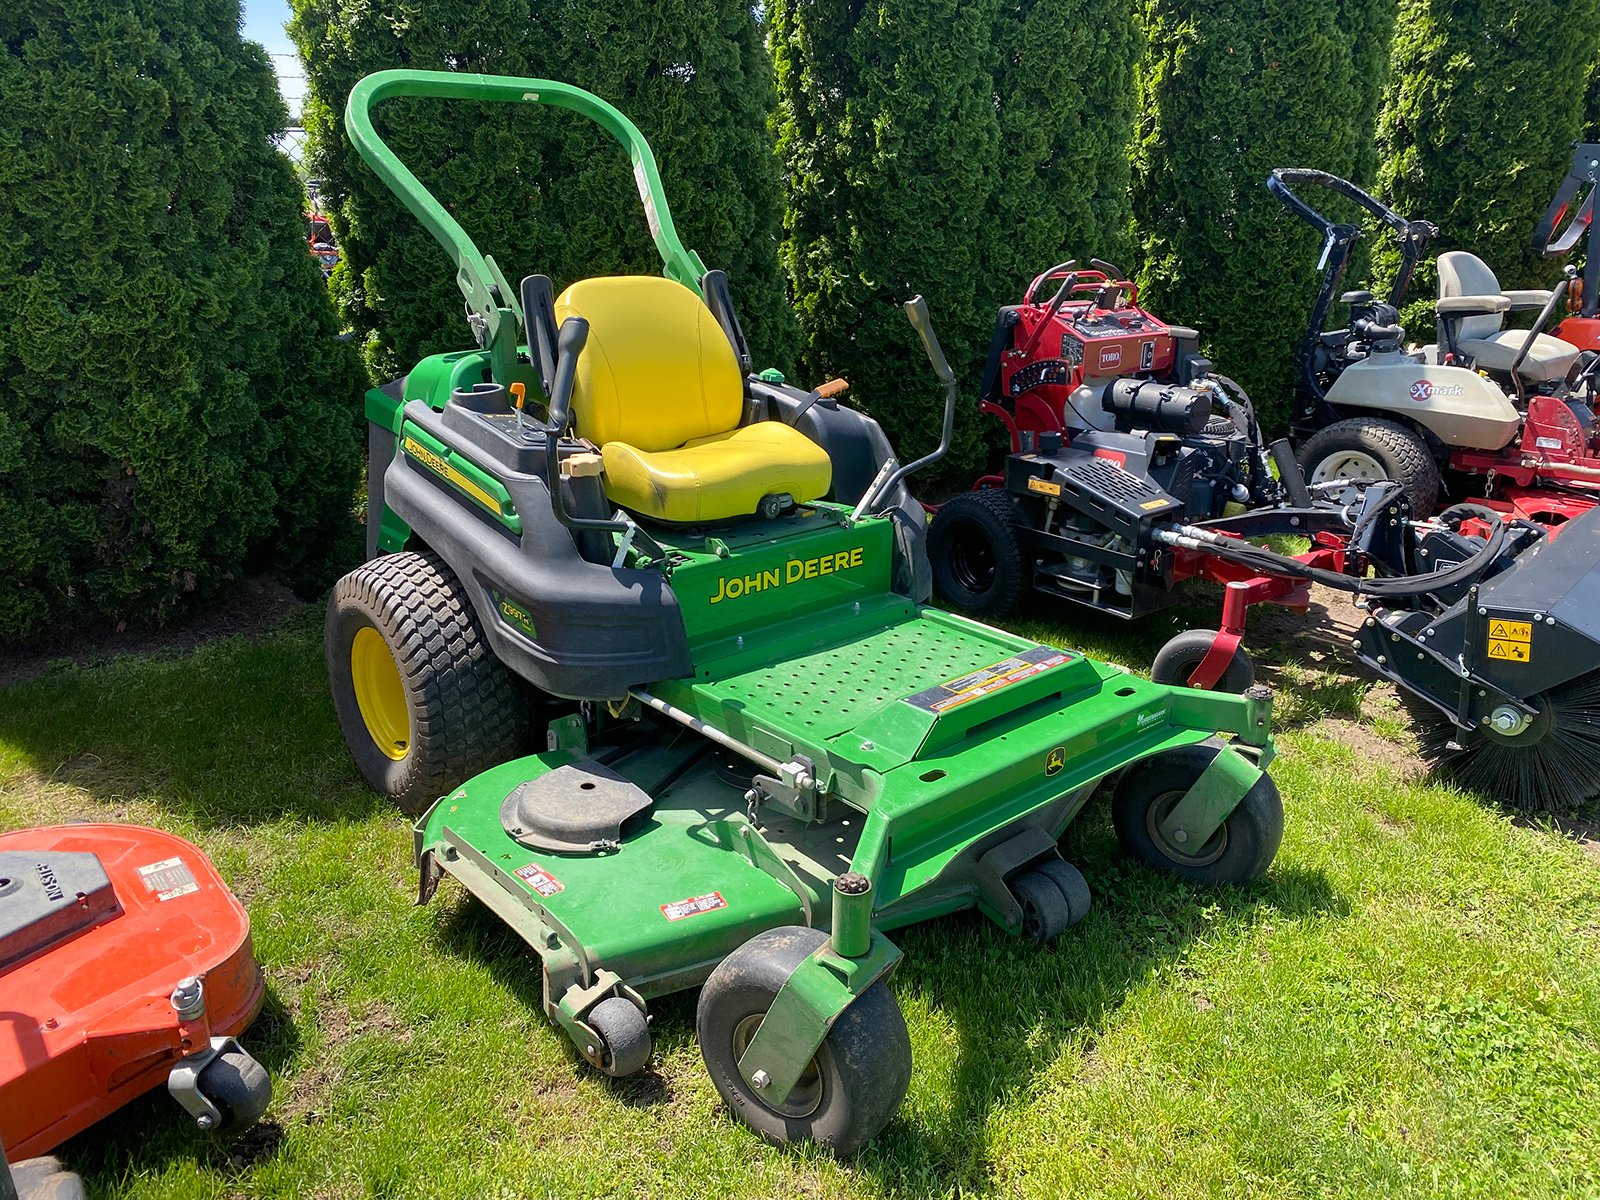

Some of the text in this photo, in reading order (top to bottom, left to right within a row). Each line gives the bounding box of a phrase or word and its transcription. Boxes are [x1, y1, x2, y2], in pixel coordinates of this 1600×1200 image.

[1101, 352, 1120, 363] TORO
[409, 441, 450, 479] JOHN DEERE
[710, 547, 864, 604] JOHN DEERE
[46, 884, 64, 901] NO
